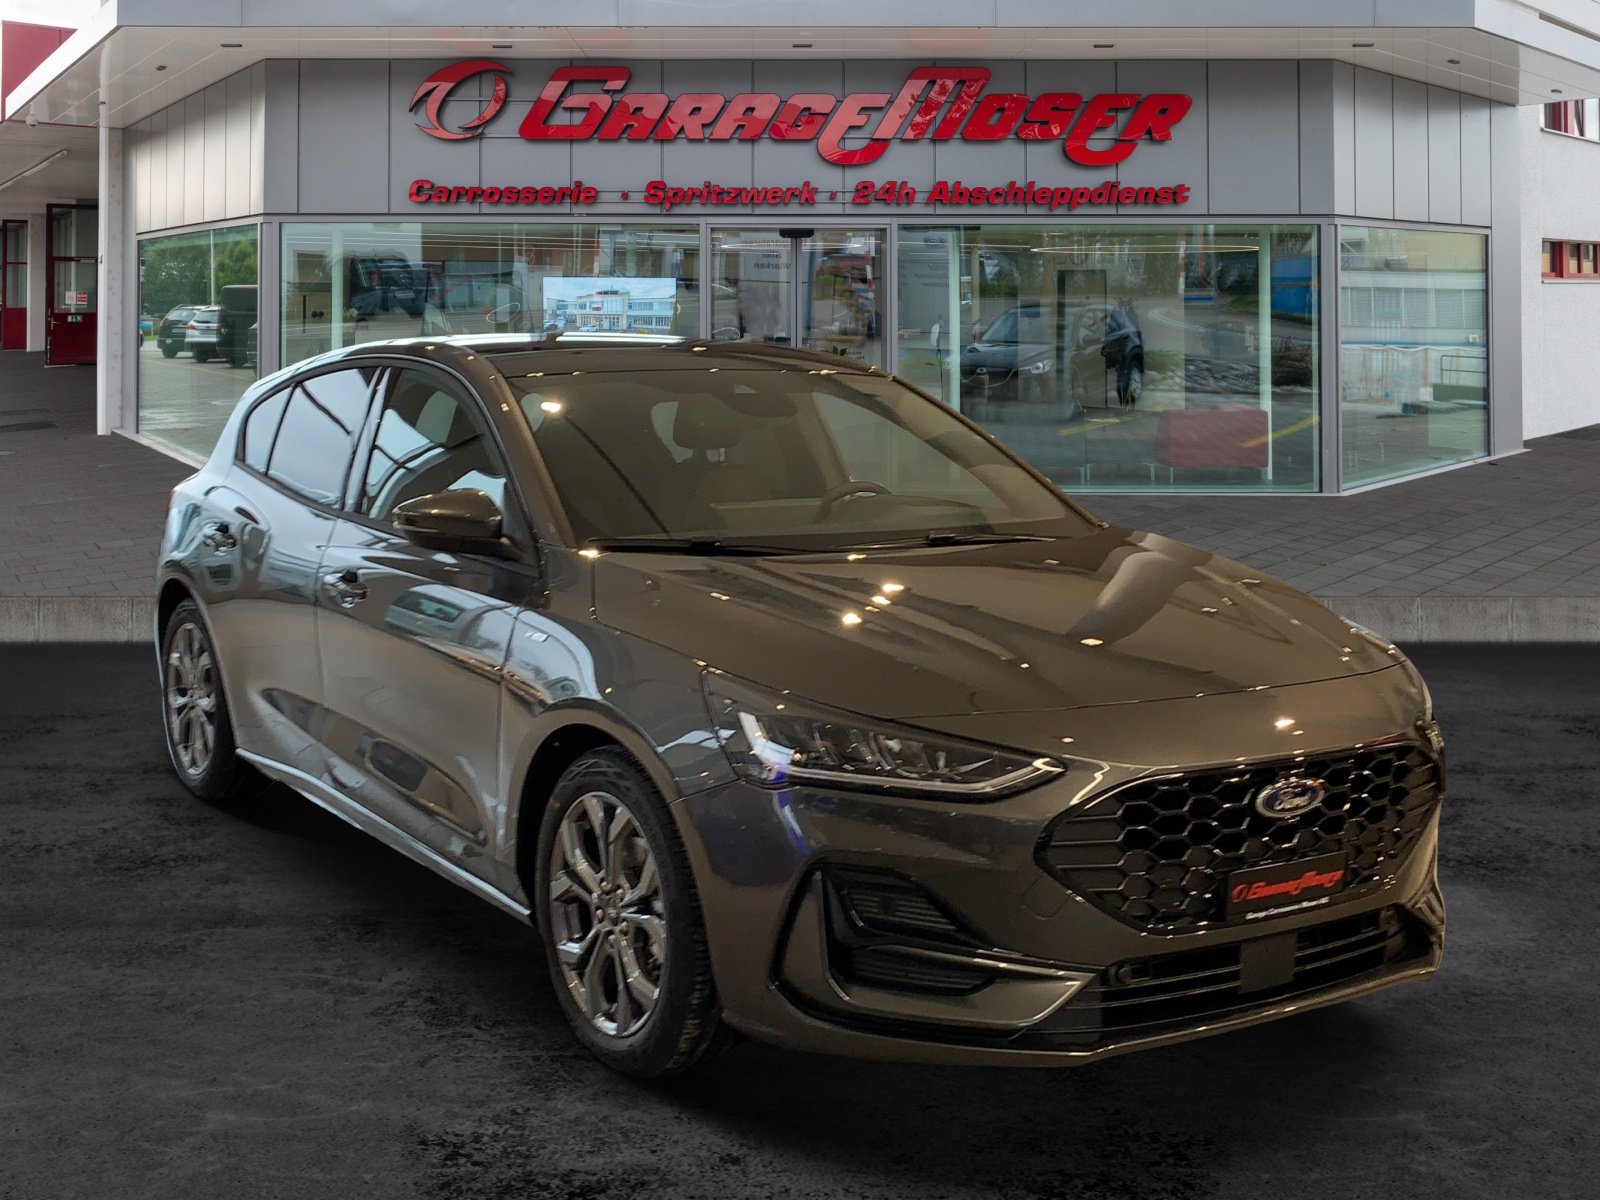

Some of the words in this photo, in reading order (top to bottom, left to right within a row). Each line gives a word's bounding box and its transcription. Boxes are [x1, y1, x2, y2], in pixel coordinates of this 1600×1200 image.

[408, 179, 598, 204] Carrosserie
[643, 180, 817, 209] Spritzwerk
[852, 180, 917, 204] 24h
[927, 180, 1190, 210] Abschleppdienst
